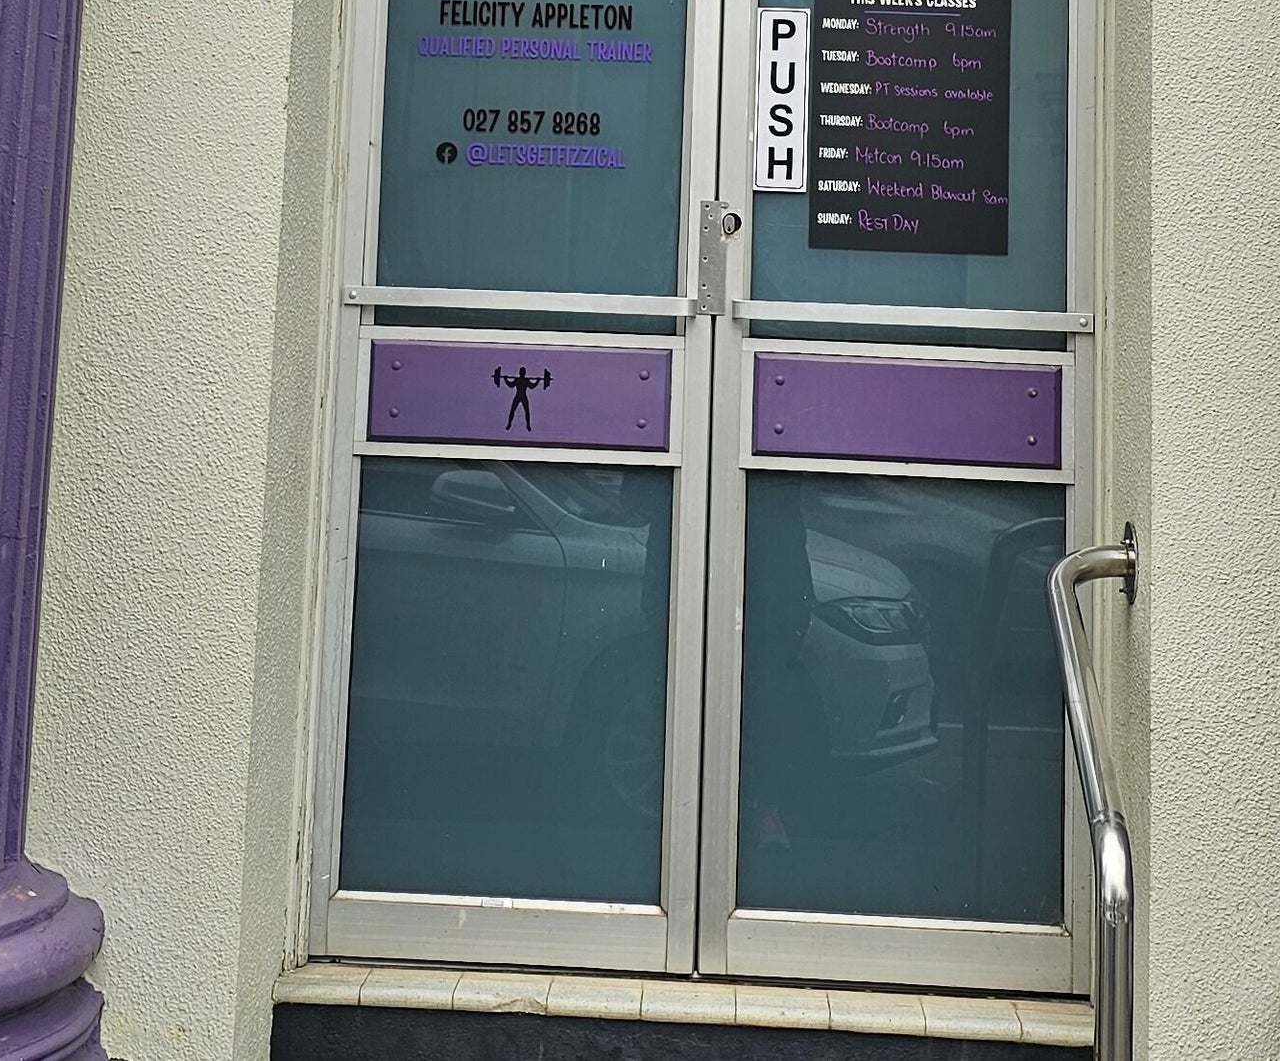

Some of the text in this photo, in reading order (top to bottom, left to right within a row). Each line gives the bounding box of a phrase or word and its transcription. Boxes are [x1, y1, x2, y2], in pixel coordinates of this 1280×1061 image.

[439, 0, 633, 31] FELICITY APPLETON
[822, 17, 997, 44] MONDAY: Strength 9.15am
[417, 36, 653, 63] QUALIFIED PERSONAL TRAINER
[821, 49, 983, 73] TUESDAY: Bootcamp 6pm
[767, 18, 796, 181] PUSH
[820, 81, 993, 102] WEDNESDAY: PT sessions available
[463, 108, 601, 136] 027 857 8268
[819, 113, 975, 139] THURSDAY: Bootcamp 6pm
[466, 142, 627, 170] @LETSGETFIZZICAL
[819, 147, 849, 159] FRIDAY:
[910, 150, 964, 170] 9.15am
[818, 180, 861, 192] SATURDAY:
[866, 177, 924, 199] Weekend
[982, 189, 1009, 206] 8am
[817, 213, 852, 225] SUNDAY:
[892, 213, 920, 235] DAY
